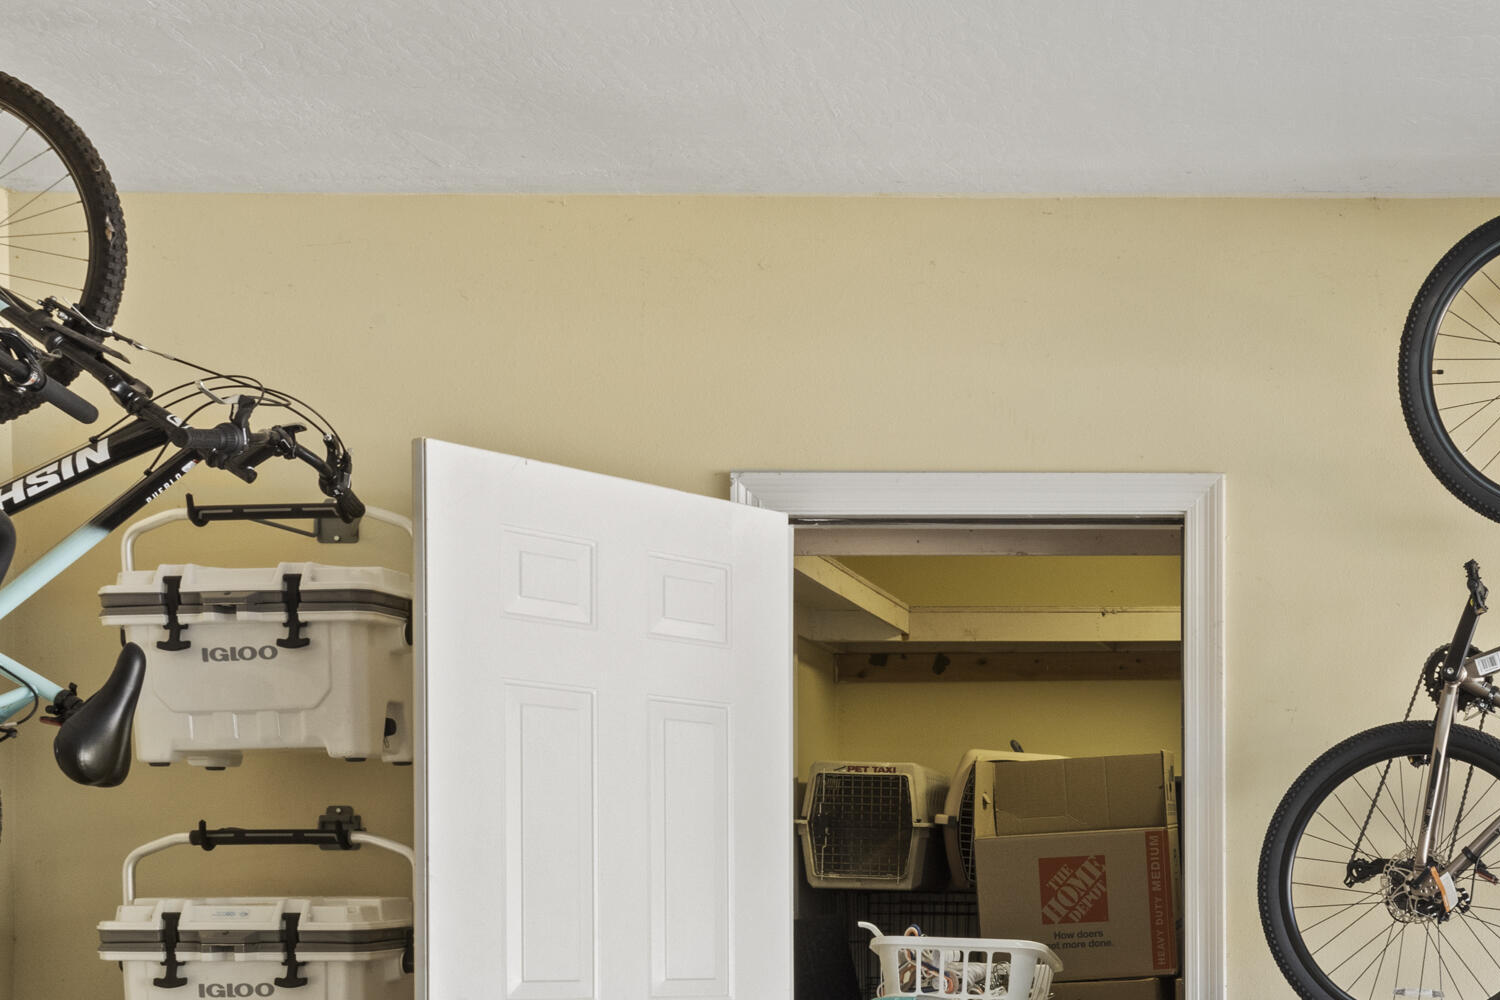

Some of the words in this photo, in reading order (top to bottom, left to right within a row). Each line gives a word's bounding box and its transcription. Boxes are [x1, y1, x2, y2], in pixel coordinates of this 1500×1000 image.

[201, 645, 278, 663] IGLOO
[847, 765, 870, 773] PET
[872, 766, 897, 774] TAXI
[1046, 863, 1074, 890] THE
[1150, 835, 1162, 892] MEDIUM
[1041, 855, 1107, 924] HOME
[1068, 880, 1107, 922] DEPOT
[1153, 896, 1164, 925] DUTY
[1053, 930, 1075, 940] How
[1077, 929, 1104, 938] doers
[1063, 941, 1087, 949] more
[1155, 930, 1166, 965] HEAVY
[198, 982, 275, 998] IGLOO
